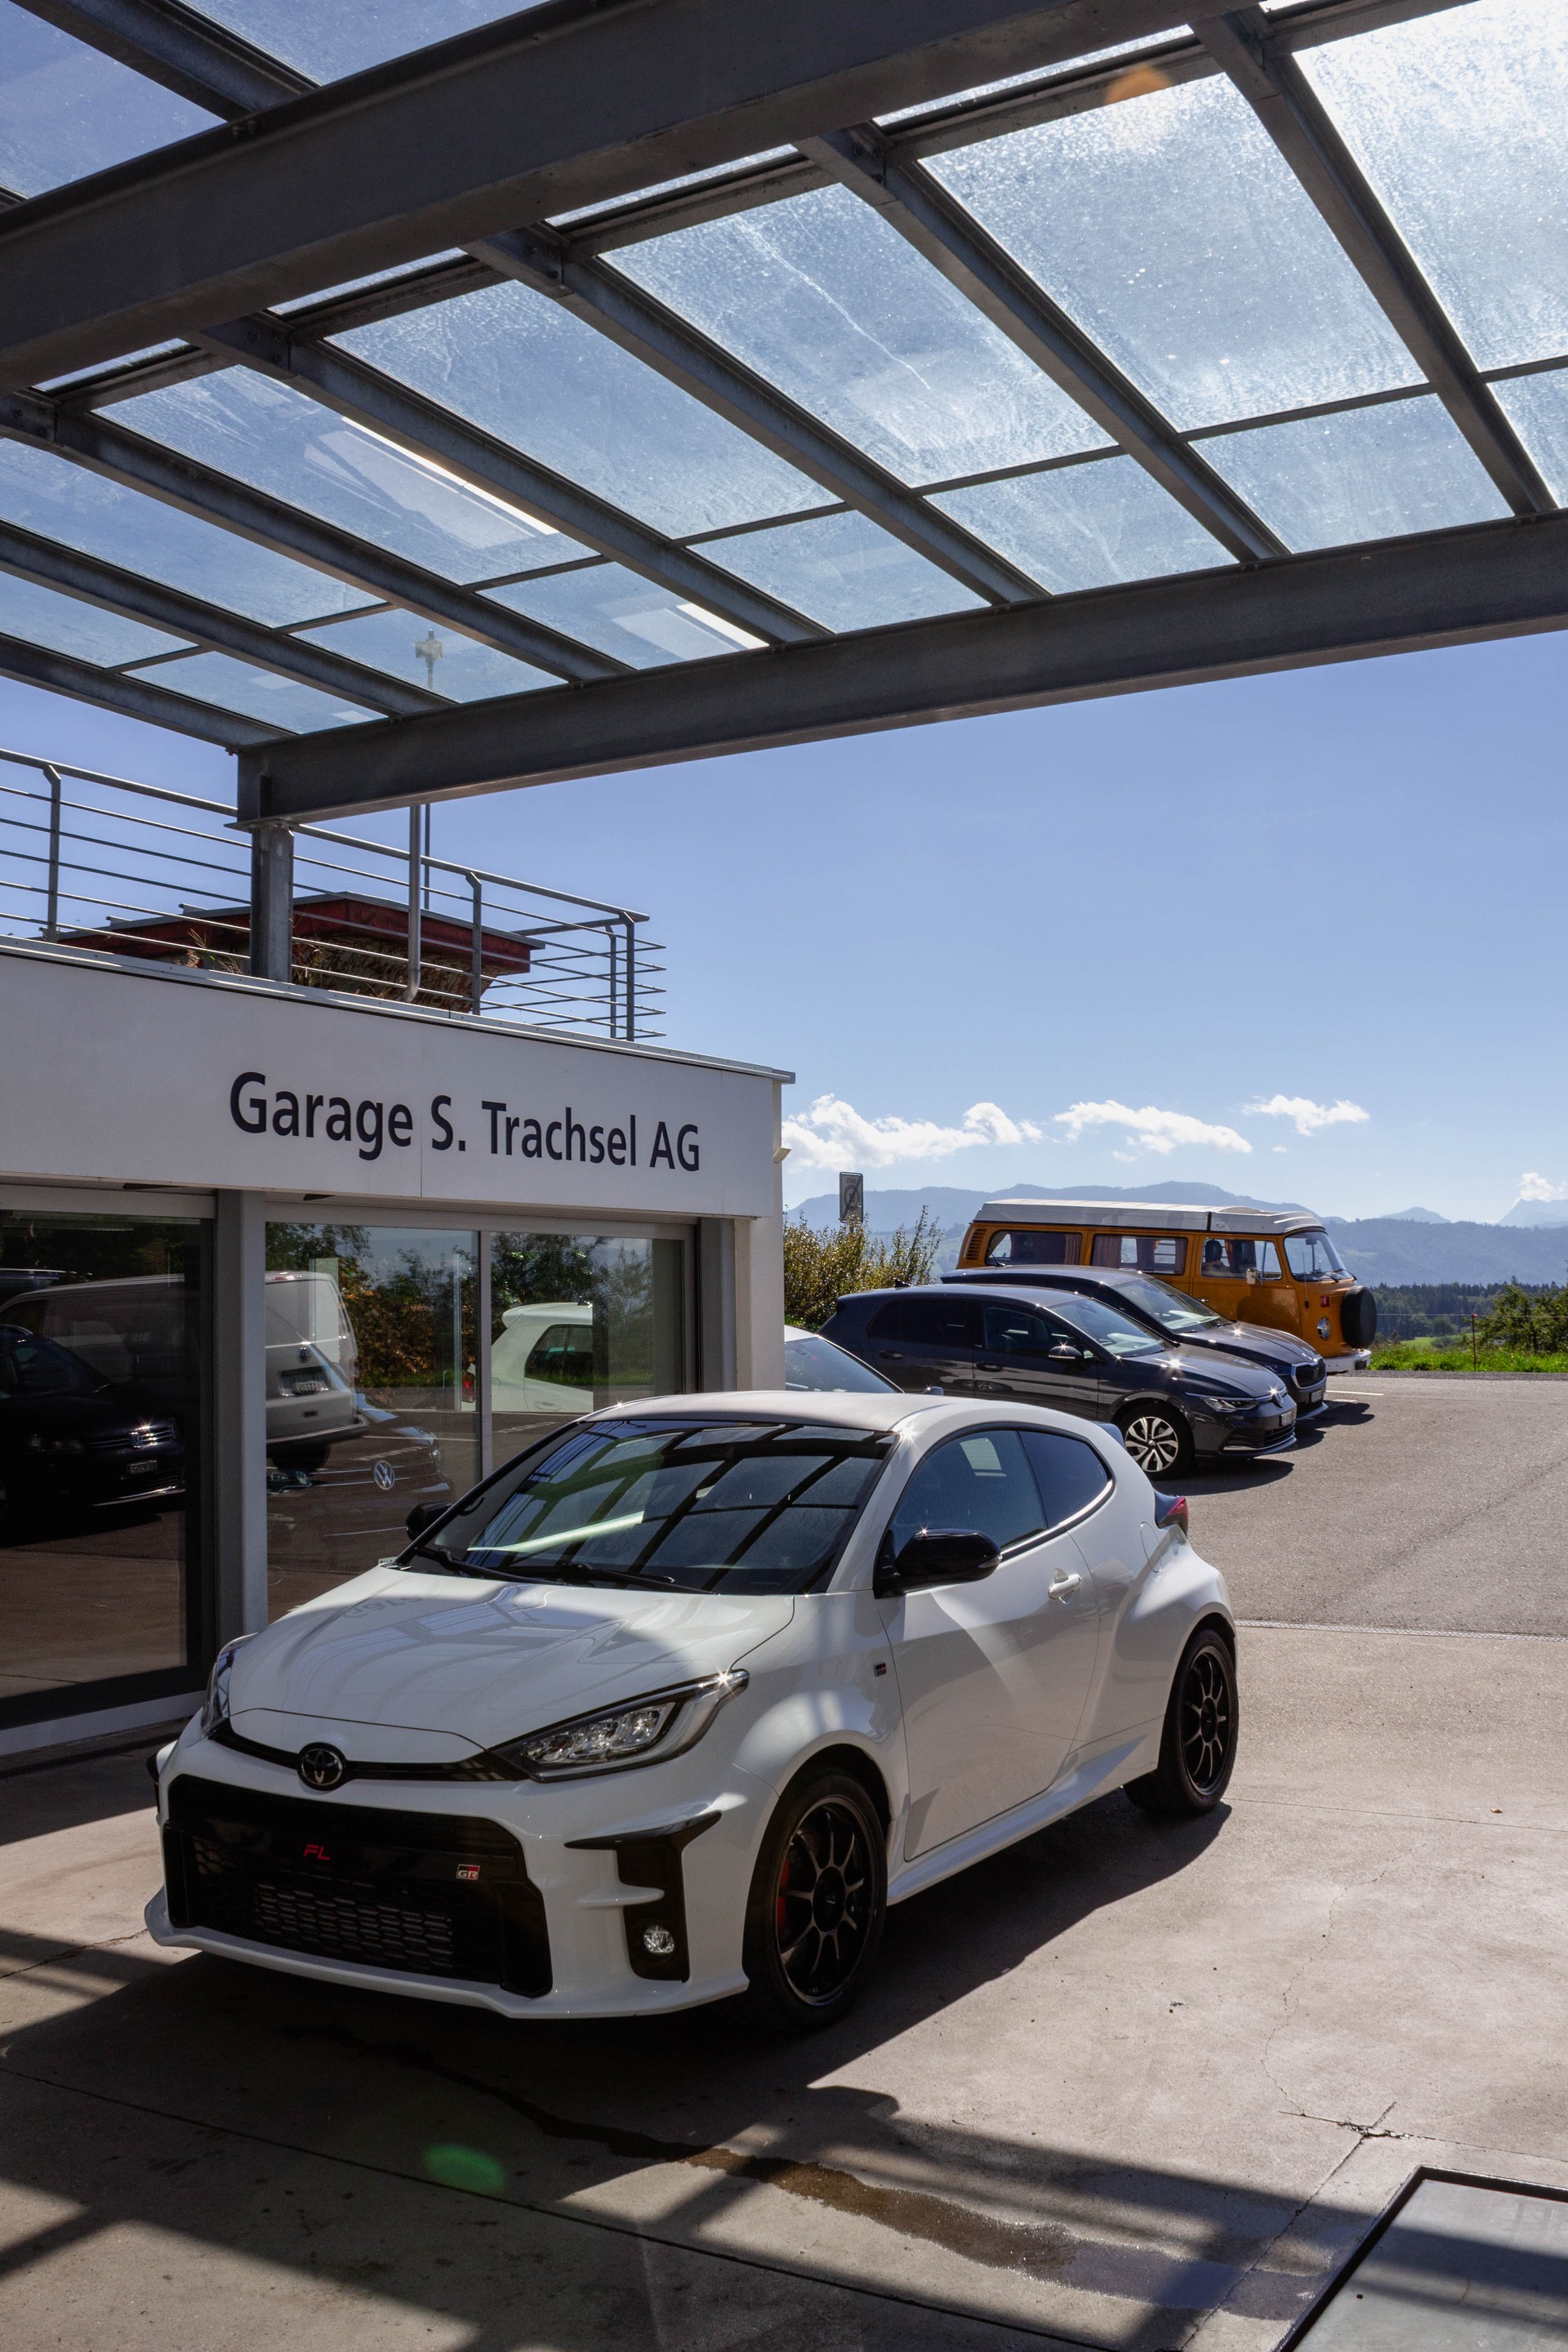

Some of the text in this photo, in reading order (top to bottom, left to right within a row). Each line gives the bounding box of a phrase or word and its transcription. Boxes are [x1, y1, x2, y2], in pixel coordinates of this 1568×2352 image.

[230, 1071, 700, 1172] Garage S. Trachsel AG
[303, 1843, 330, 1861] FL
[457, 1869, 479, 1879] GR
